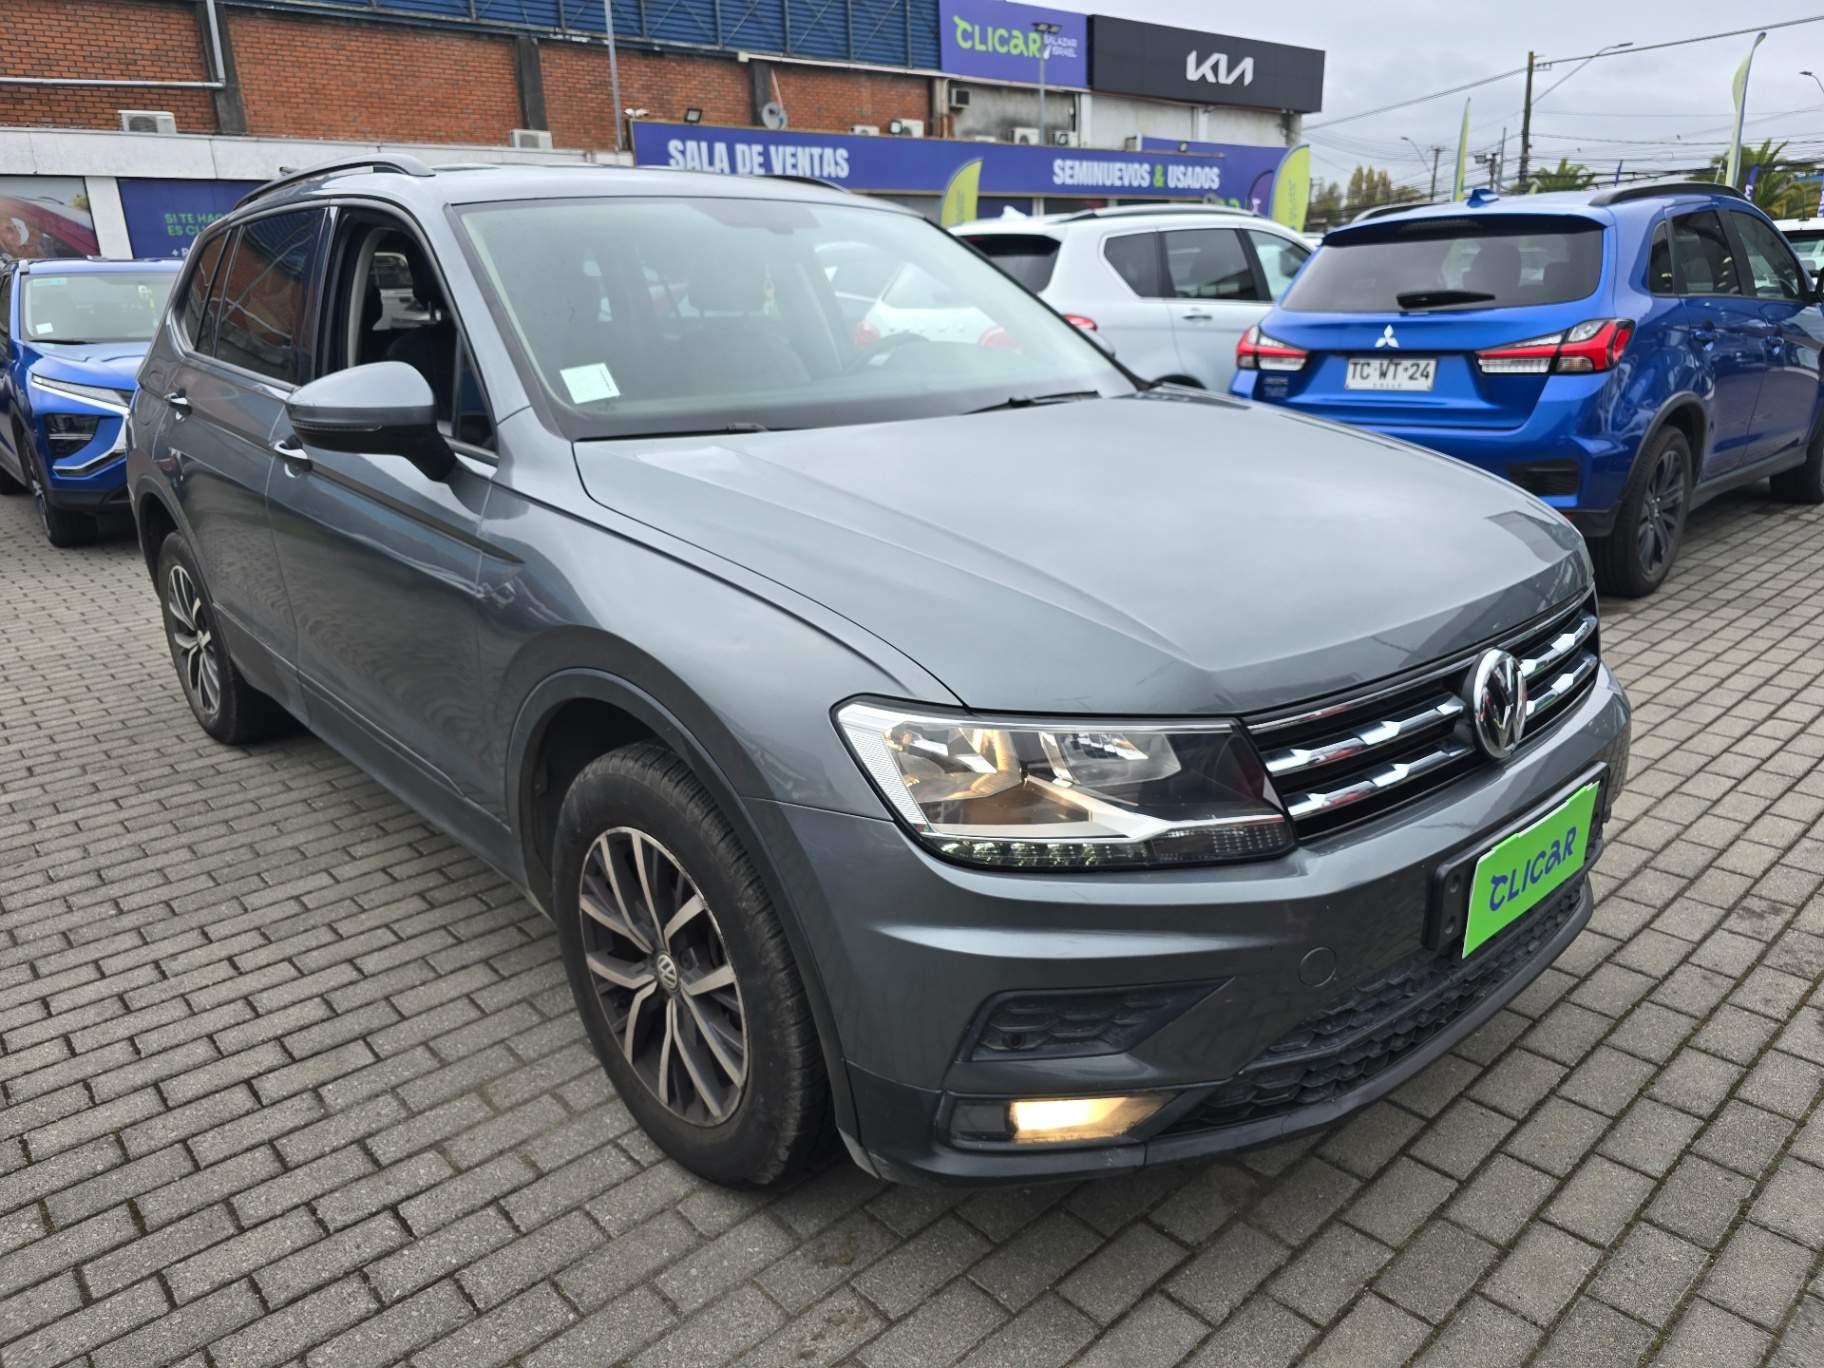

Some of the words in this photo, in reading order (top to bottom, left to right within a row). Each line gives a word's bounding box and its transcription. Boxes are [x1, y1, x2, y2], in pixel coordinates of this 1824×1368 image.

[1186, 49, 1255, 87] KIA
[667, 138, 731, 174] SALA
[734, 143, 766, 176] DE
[768, 144, 850, 178] VENTAS
[1052, 158, 1151, 188] SEMINUEVOS
[1152, 165, 1166, 188] &
[1167, 164, 1221, 190] USADOS
[178, 213, 195, 225] TE
